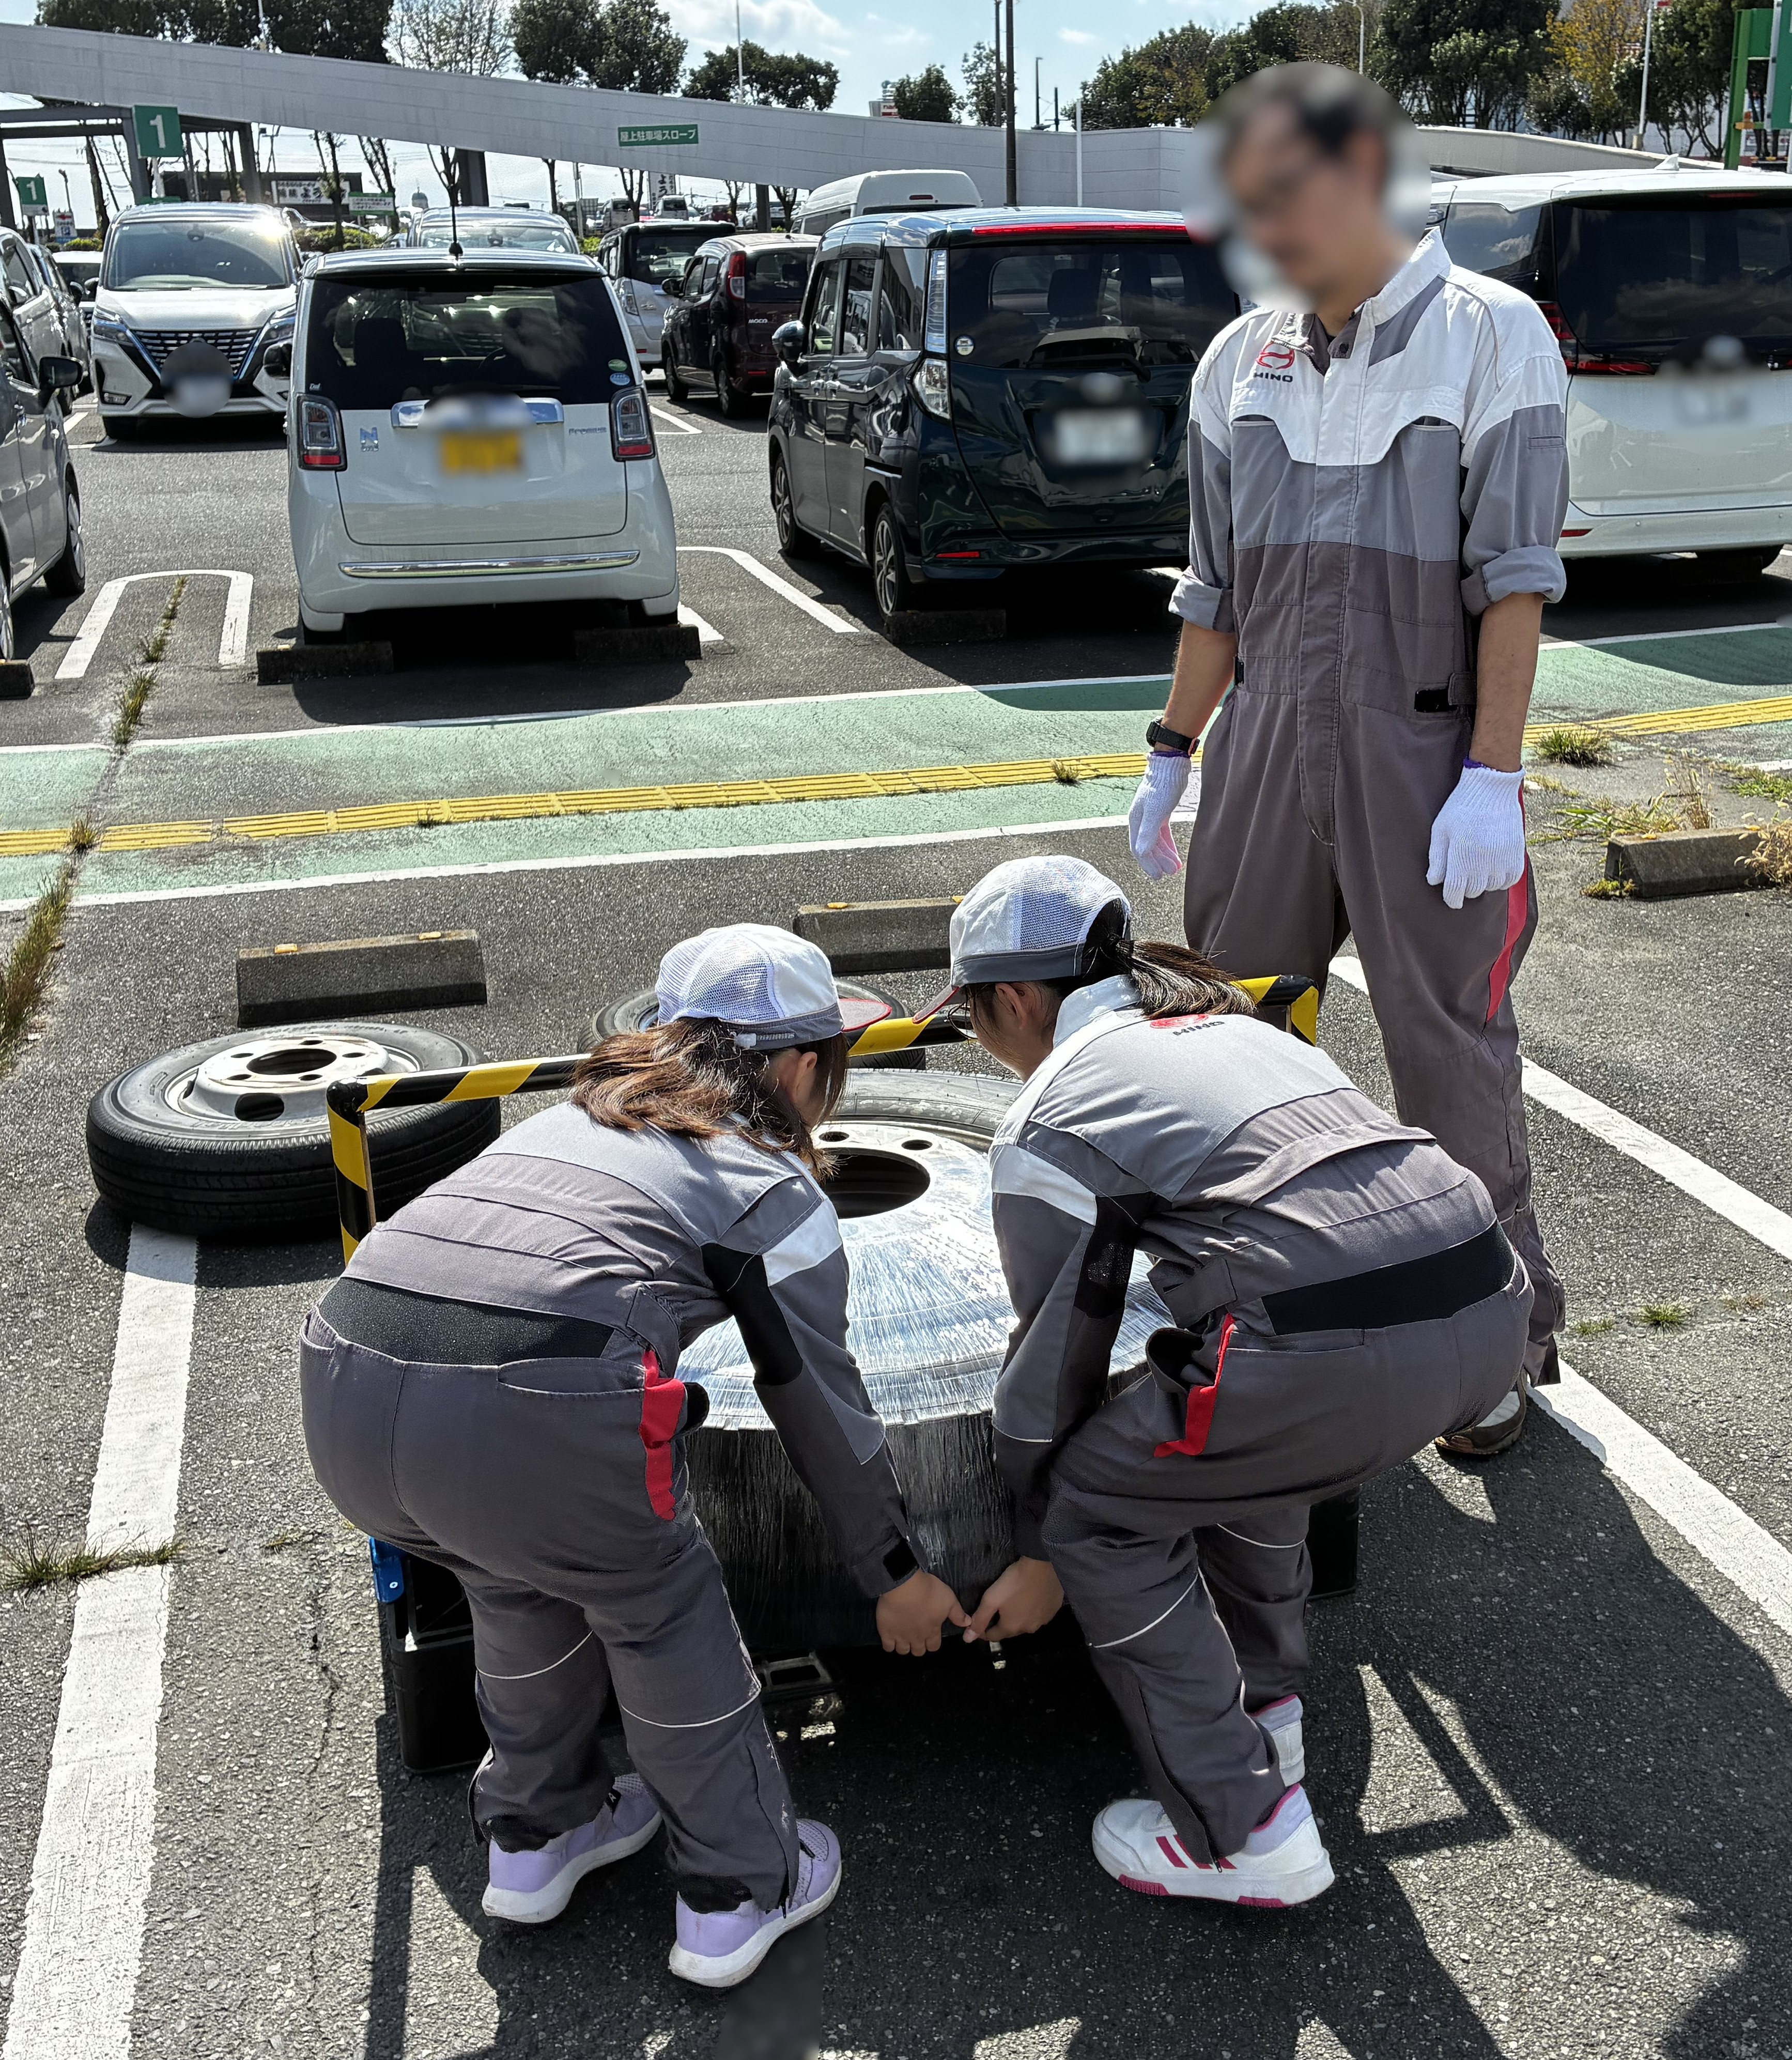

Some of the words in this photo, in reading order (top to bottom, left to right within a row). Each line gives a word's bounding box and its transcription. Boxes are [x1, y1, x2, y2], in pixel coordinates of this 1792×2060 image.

[149, 114, 166, 148] 1
[620, 129, 696, 142] 屋上駐車場スロープ
[26, 181, 37, 200] 1
[1253, 372, 1293, 383] HINO
